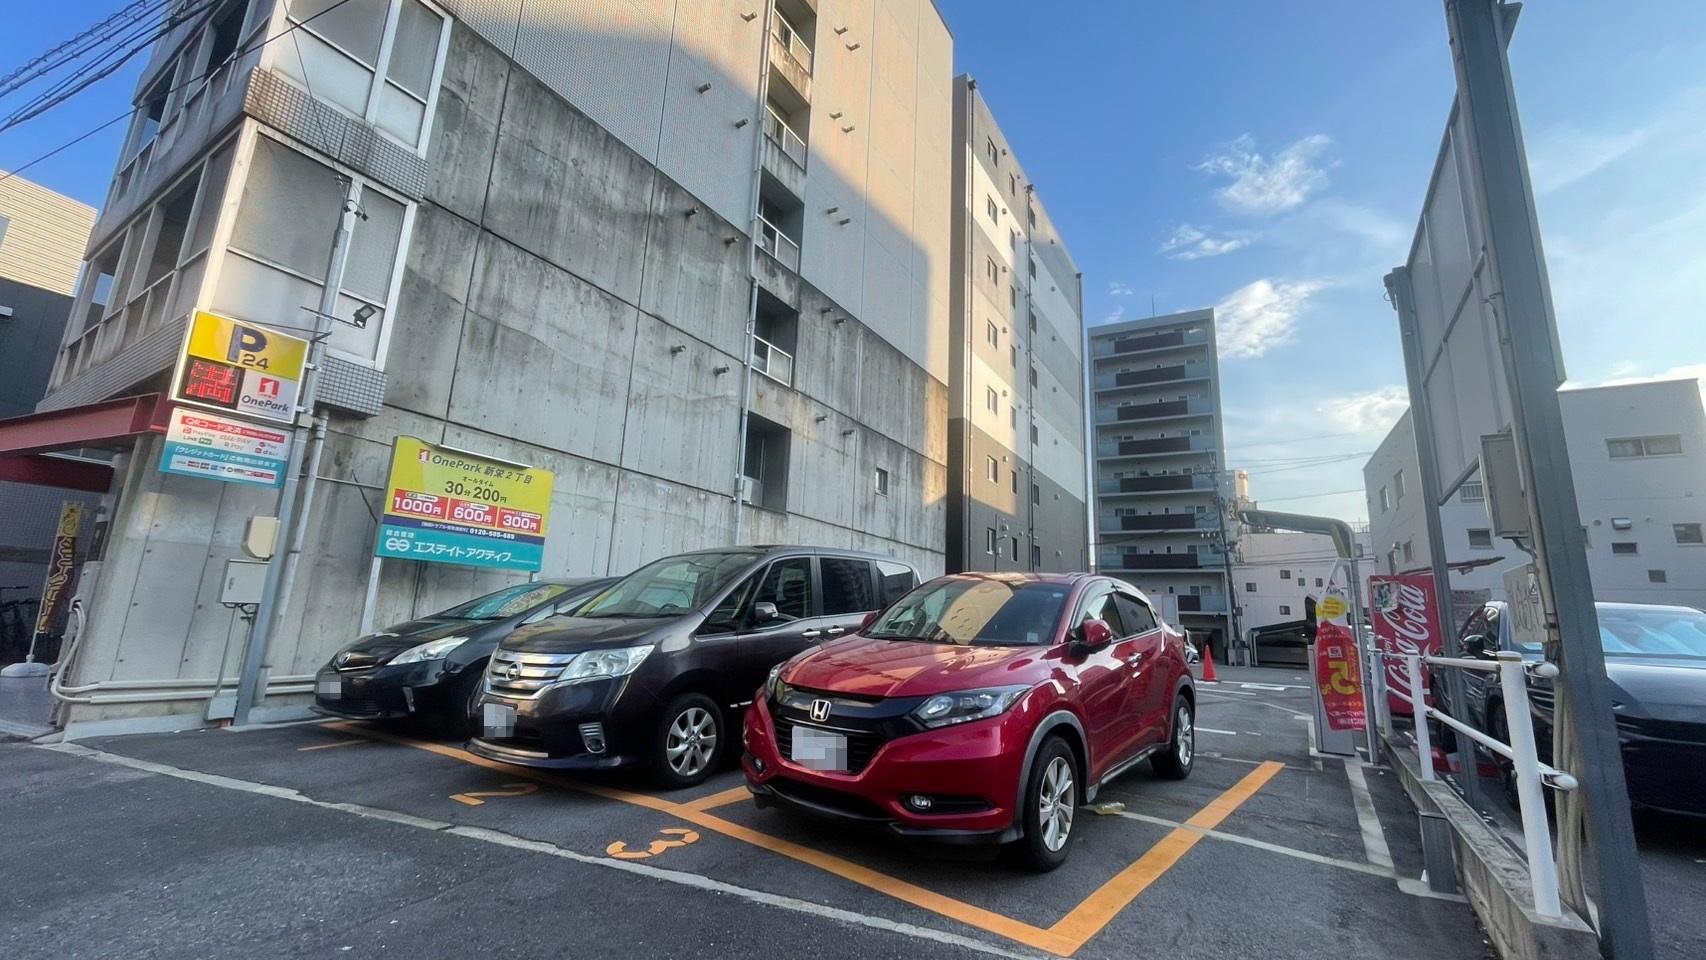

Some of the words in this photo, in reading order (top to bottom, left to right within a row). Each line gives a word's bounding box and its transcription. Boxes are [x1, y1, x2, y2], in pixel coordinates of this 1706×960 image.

[226, 324, 268, 363] P
[242, 353, 269, 370] 24
[241, 395, 289, 413] OnePark
[432, 455, 482, 473] OnePark
[444, 480, 471, 497] 30分
[473, 487, 507, 503] 200円
[394, 497, 442, 515] 1000円
[454, 507, 492, 523] 600円
[502, 515, 537, 530] 300円
[413, 541, 465, 557] エステイト
[449, 783, 538, 806] 2
[606, 828, 700, 859] 3
